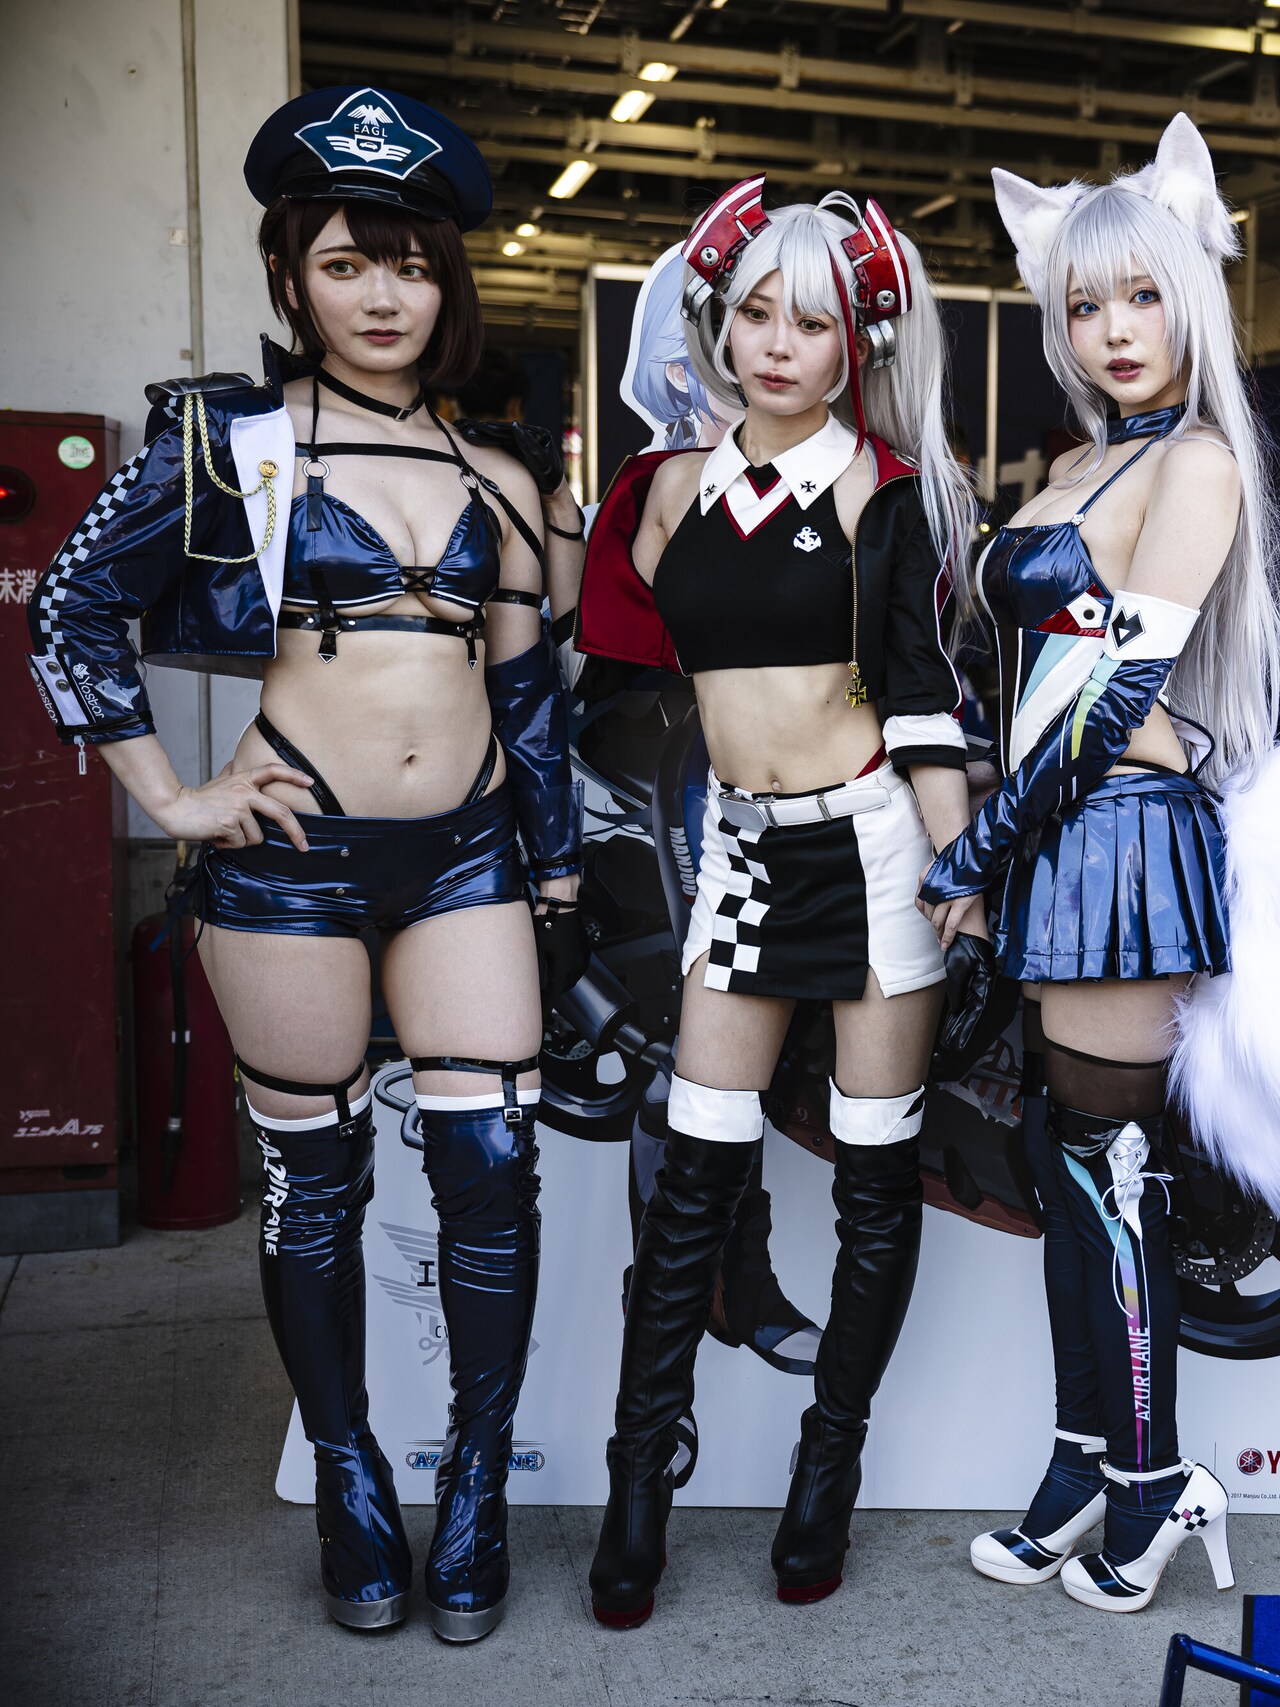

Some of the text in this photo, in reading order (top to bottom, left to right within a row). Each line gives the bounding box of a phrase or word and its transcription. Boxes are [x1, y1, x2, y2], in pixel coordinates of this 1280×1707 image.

[353, 123, 388, 138] EAGL
[0, 567, 43, 604] 末消
[37, 681, 58, 723] Yostar
[79, 676, 105, 719] Yostar
[669, 826, 697, 896] MANJUU
[417, 1260, 436, 1287] I
[1128, 1326, 1151, 1421] AZUR LANE
[508, 1452, 540, 1469] NE
